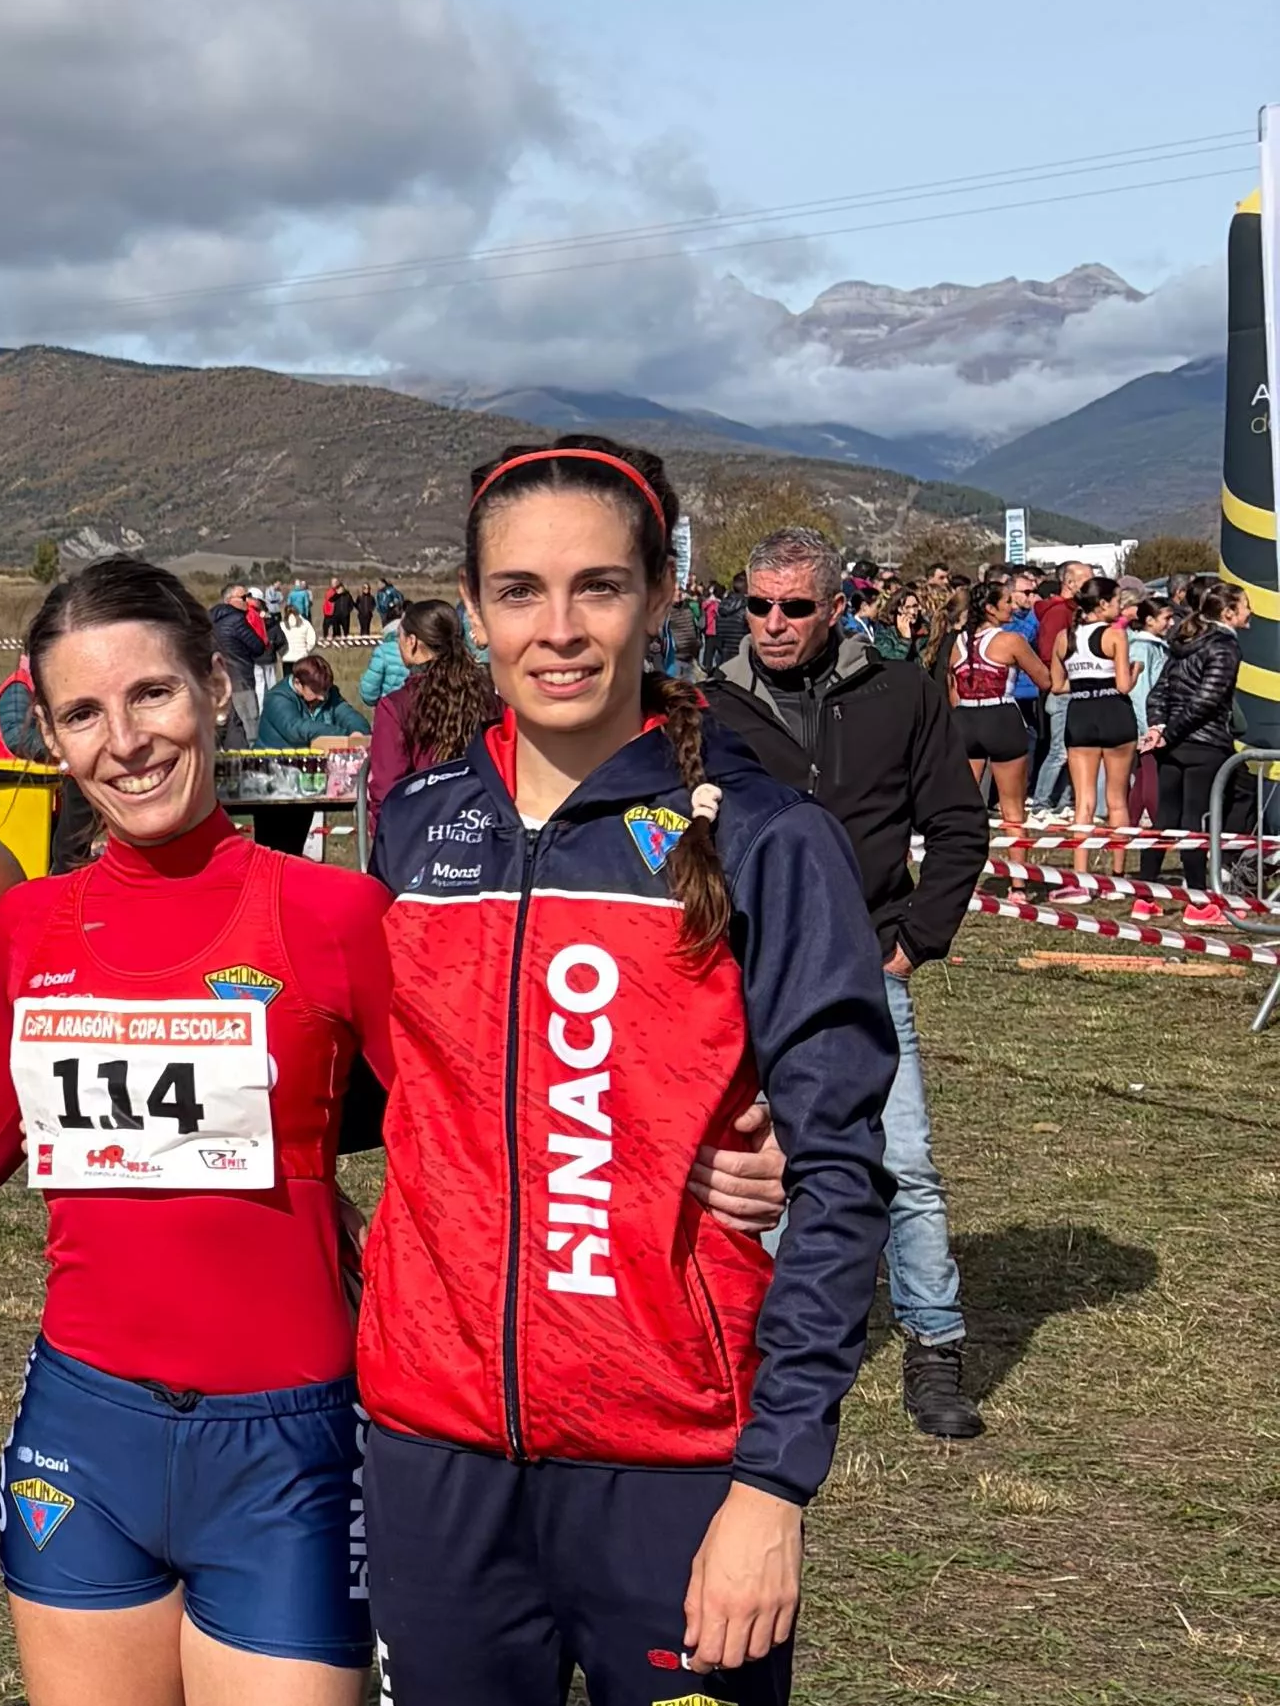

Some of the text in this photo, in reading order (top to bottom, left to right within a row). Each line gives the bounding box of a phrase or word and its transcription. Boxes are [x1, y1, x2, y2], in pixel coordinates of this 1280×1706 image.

[24, 1015, 52, 1038] COPA
[56, 1012, 113, 1038] ARAGÓN
[129, 1018, 166, 1040] COPA
[170, 1018, 246, 1041] ESCOLAR
[52, 1057, 204, 1135] 114
[546, 943, 620, 1298] HINACO
